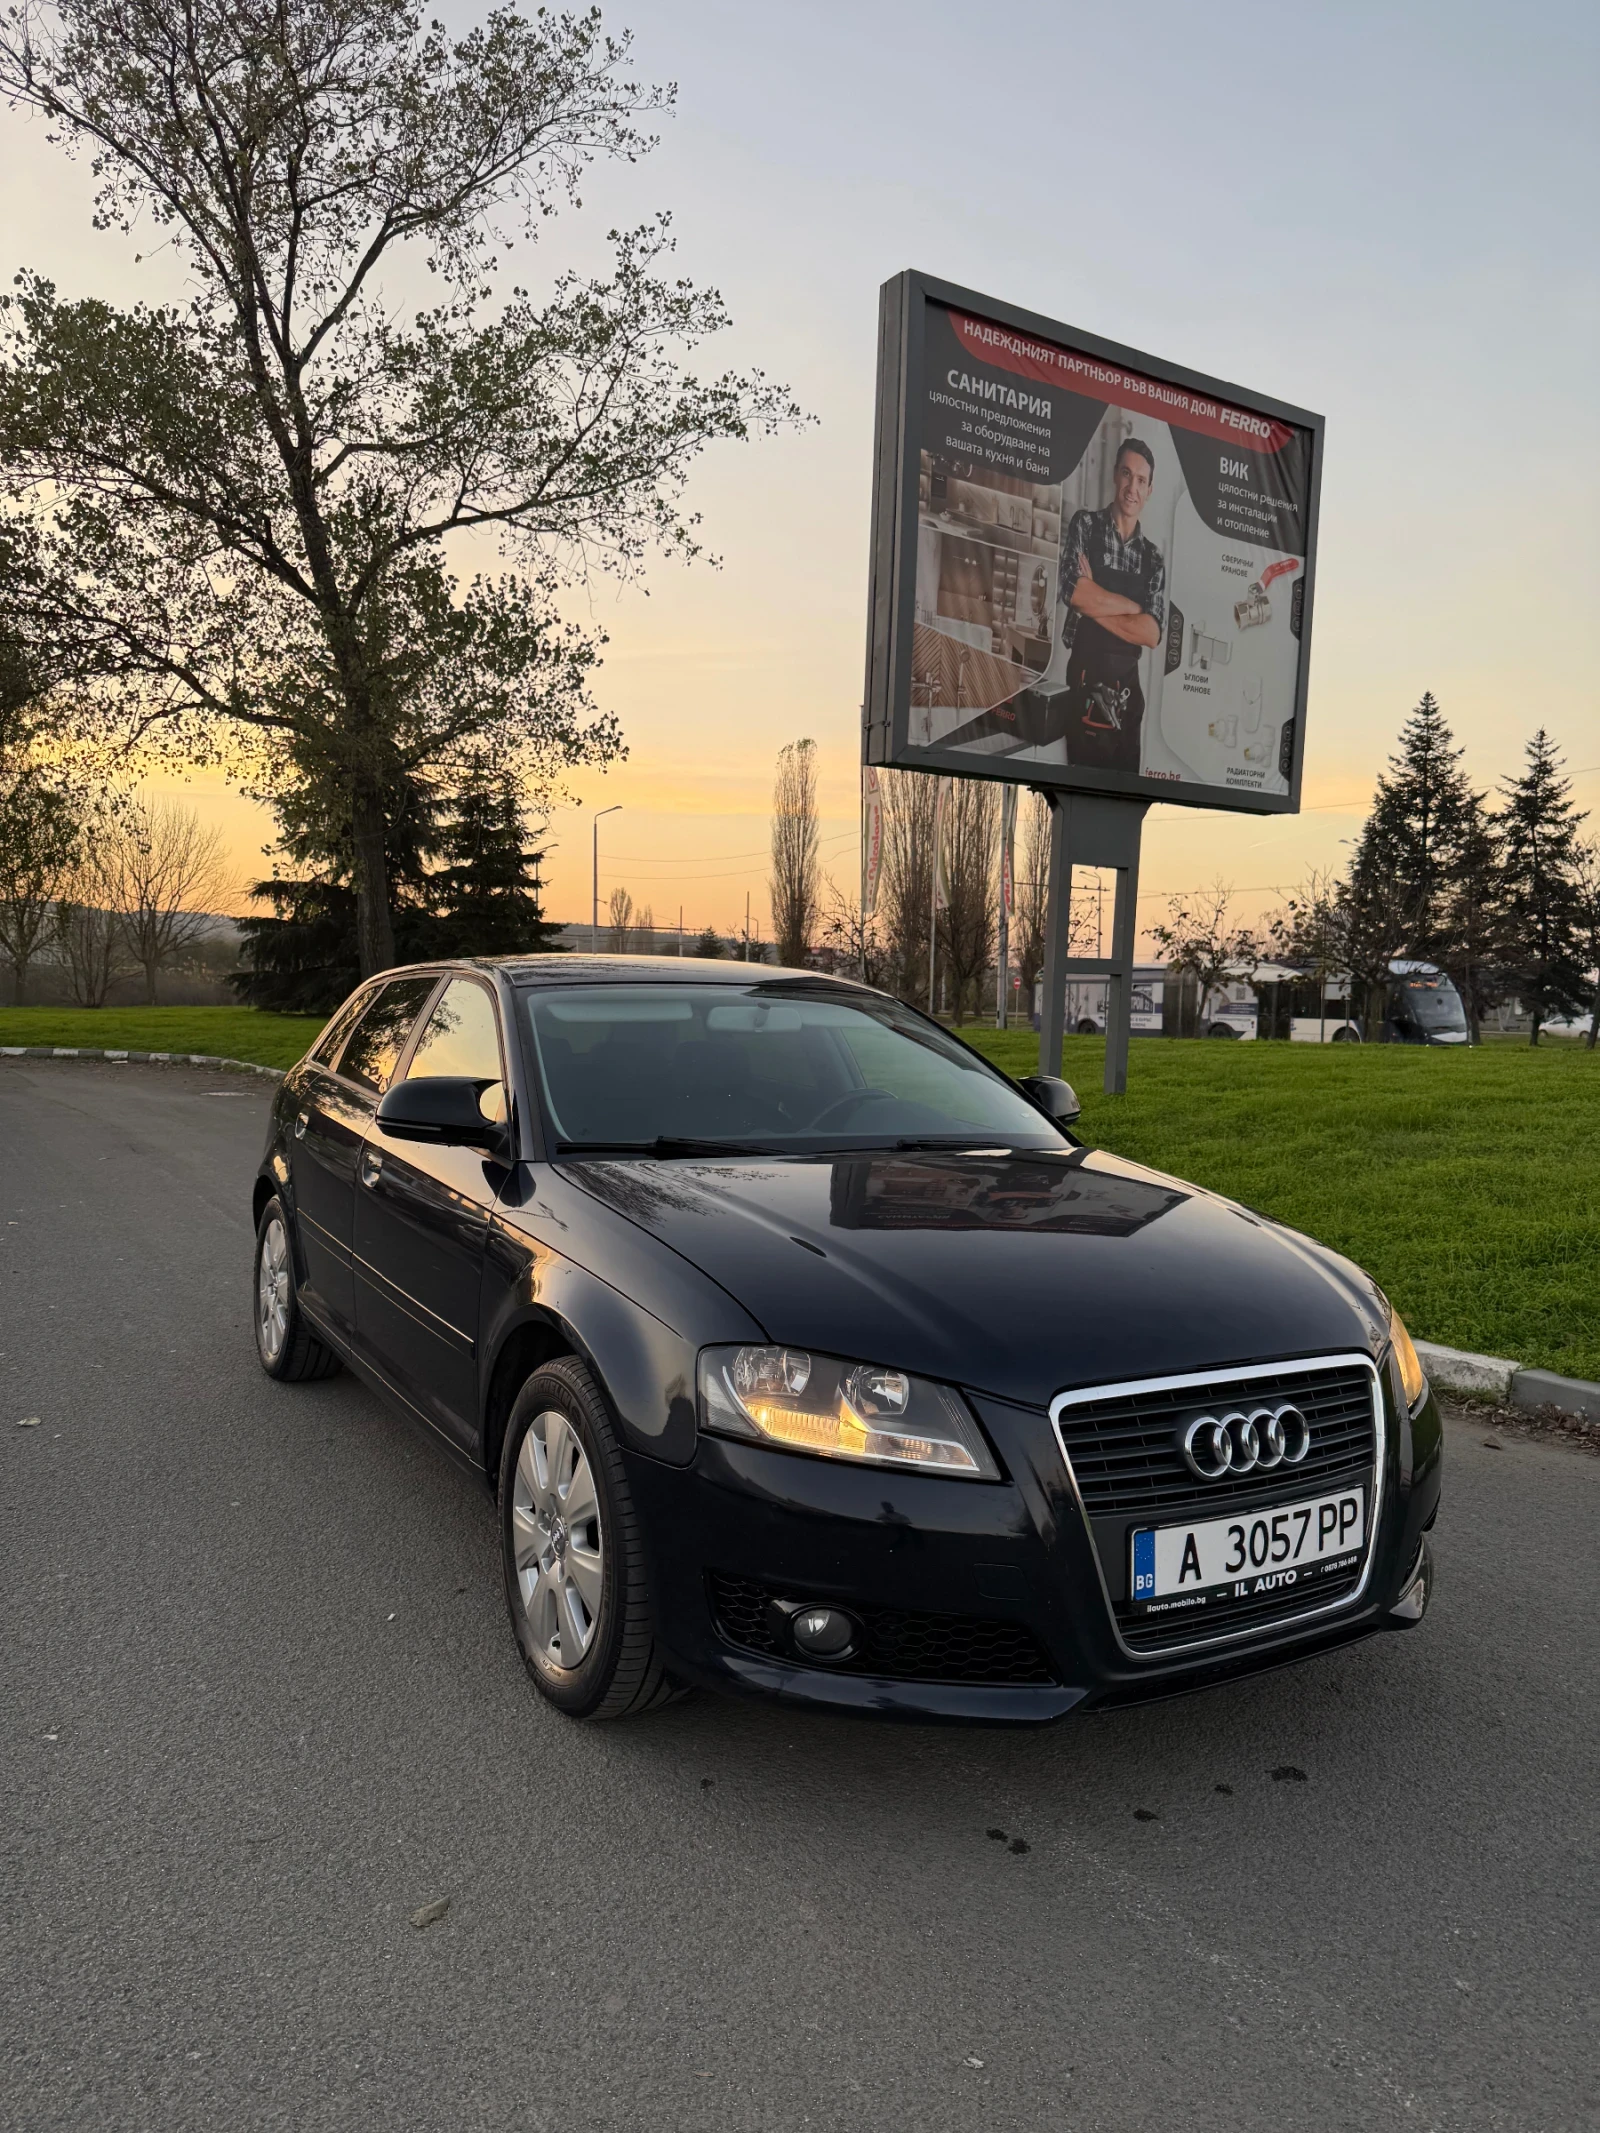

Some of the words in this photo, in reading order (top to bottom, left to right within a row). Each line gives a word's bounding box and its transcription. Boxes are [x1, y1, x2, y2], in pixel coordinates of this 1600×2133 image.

[964, 320, 1055, 365] НАДЕЖДНИЯТ
[1058, 354, 1122, 386] ПАРТНЬОР
[1123, 377, 1147, 394] ВЪВ
[1148, 384, 1189, 409] ВАШИЯ
[1190, 399, 1217, 419] ДОМ
[947, 369, 1052, 419] САНИТАРИЯ
[929, 390, 979, 415] цялостни
[980, 408, 1051, 439] предложения
[1219, 408, 1271, 439] FERRO
[961, 421, 972, 433] за
[974, 425, 1037, 452] оборудване
[1038, 446, 1050, 457] на
[945, 435, 983, 456] вашата
[985, 446, 1015, 466] кухня
[1016, 457, 1023, 468] и
[1025, 457, 1050, 476] баня
[1219, 456, 1249, 482] ВИК
[1217, 499, 1227, 509] за
[1228, 502, 1278, 524] инсталации
[1218, 482, 1258, 501] цялостни
[1259, 494, 1298, 513] решения
[1217, 516, 1223, 526] и
[1224, 519, 1270, 539] отопление
[1220, 565, 1248, 578] КРАНОВЕ
[1221, 553, 1254, 569] СФЕРИЧНИ
[1182, 684, 1211, 696] КРАНОВЕ
[1226, 766, 1265, 779] РАДИАТОРНИ
[1178, 1532, 1202, 1584] A
[1225, 1508, 1312, 1573] 3057
[1318, 1497, 1358, 1551] PP
[1136, 1574, 1153, 1591] BG
[1234, 1582, 1248, 1598] IL
[1254, 1570, 1297, 1593] AUTO
